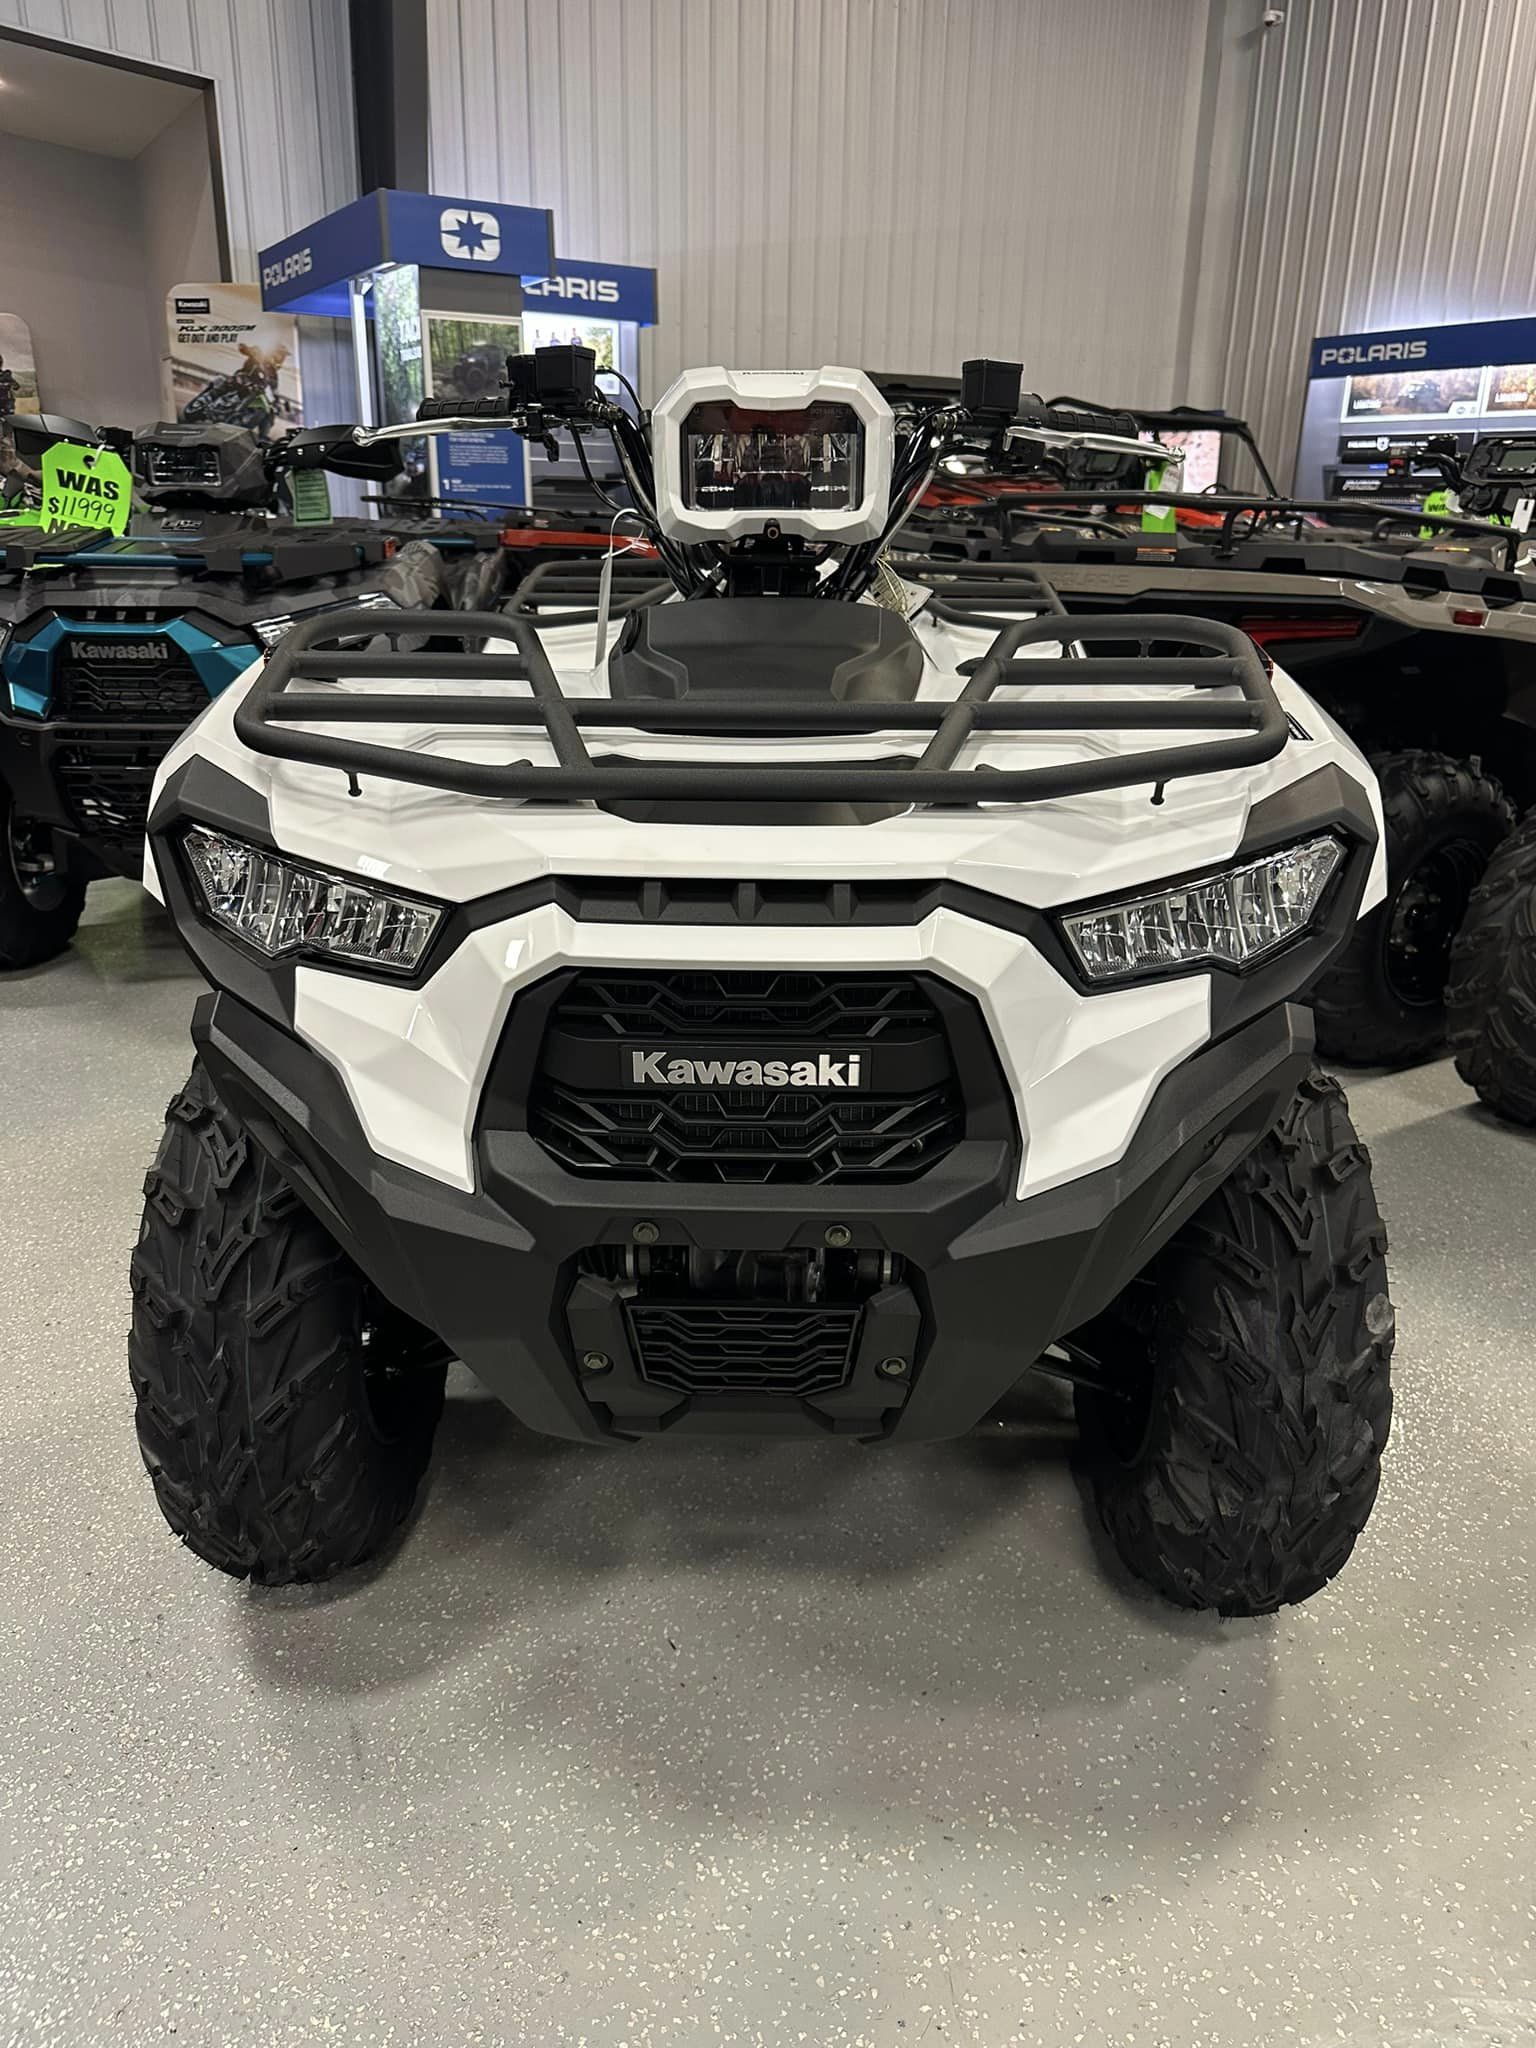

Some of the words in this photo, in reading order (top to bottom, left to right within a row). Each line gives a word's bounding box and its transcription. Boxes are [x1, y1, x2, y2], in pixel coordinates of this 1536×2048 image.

[263, 248, 312, 290] POLARIS
[525, 277, 620, 303] LARIS
[1321, 341, 1427, 366] POLARIS
[56, 468, 119, 500] WAS
[71, 642, 168, 659] Kawasaki
[632, 1051, 861, 1087] Kawasaki
